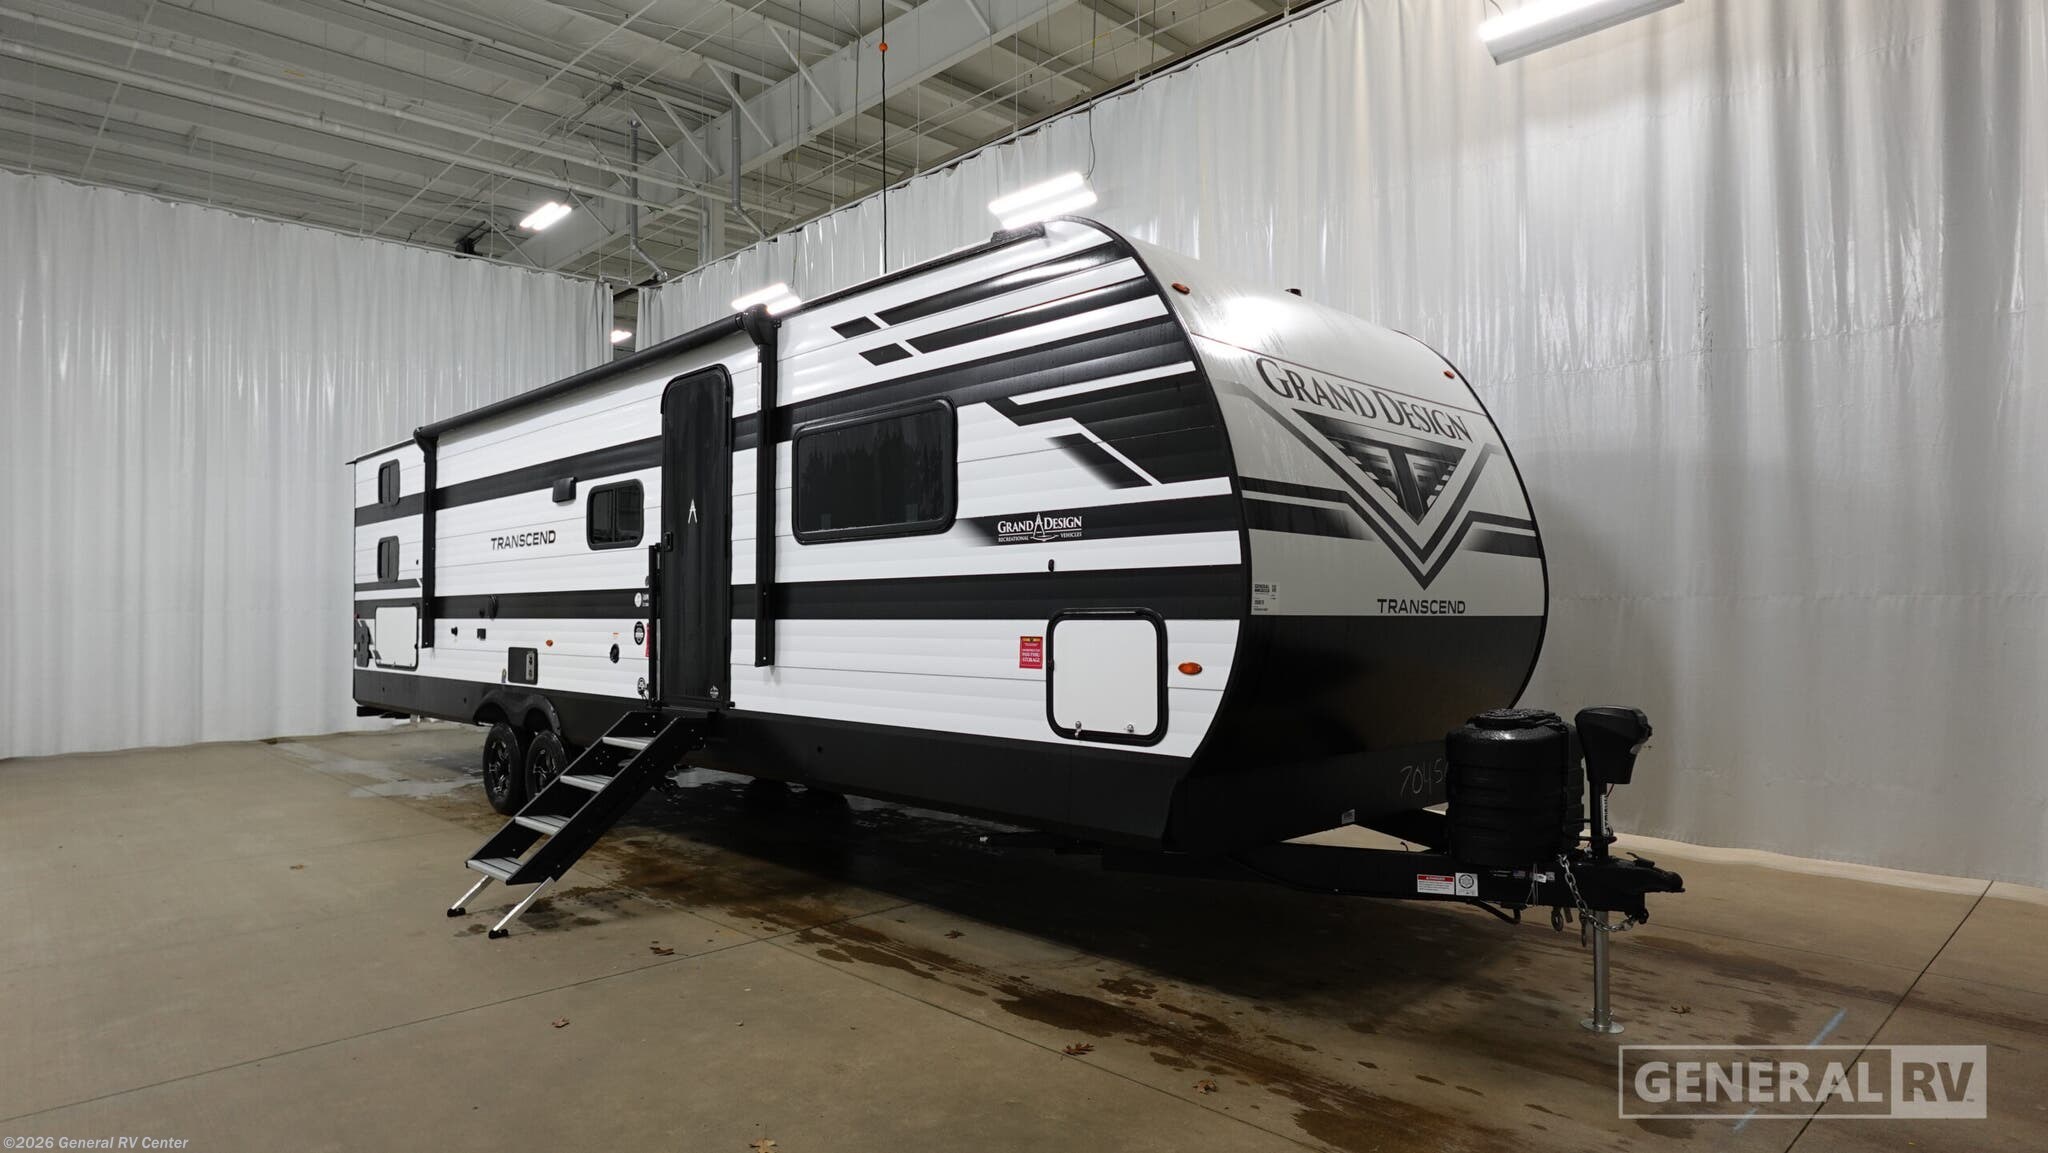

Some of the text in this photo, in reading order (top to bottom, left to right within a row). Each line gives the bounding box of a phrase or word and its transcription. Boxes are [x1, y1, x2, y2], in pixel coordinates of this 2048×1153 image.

[1256, 357, 1474, 443] GRAND DESIGN
[997, 516, 1082, 534] GRAND DESIGN
[490, 530, 557, 551] TRANSCEND
[1377, 598, 1466, 614] TRANSCEND
[1399, 758, 1449, 798] 7045
